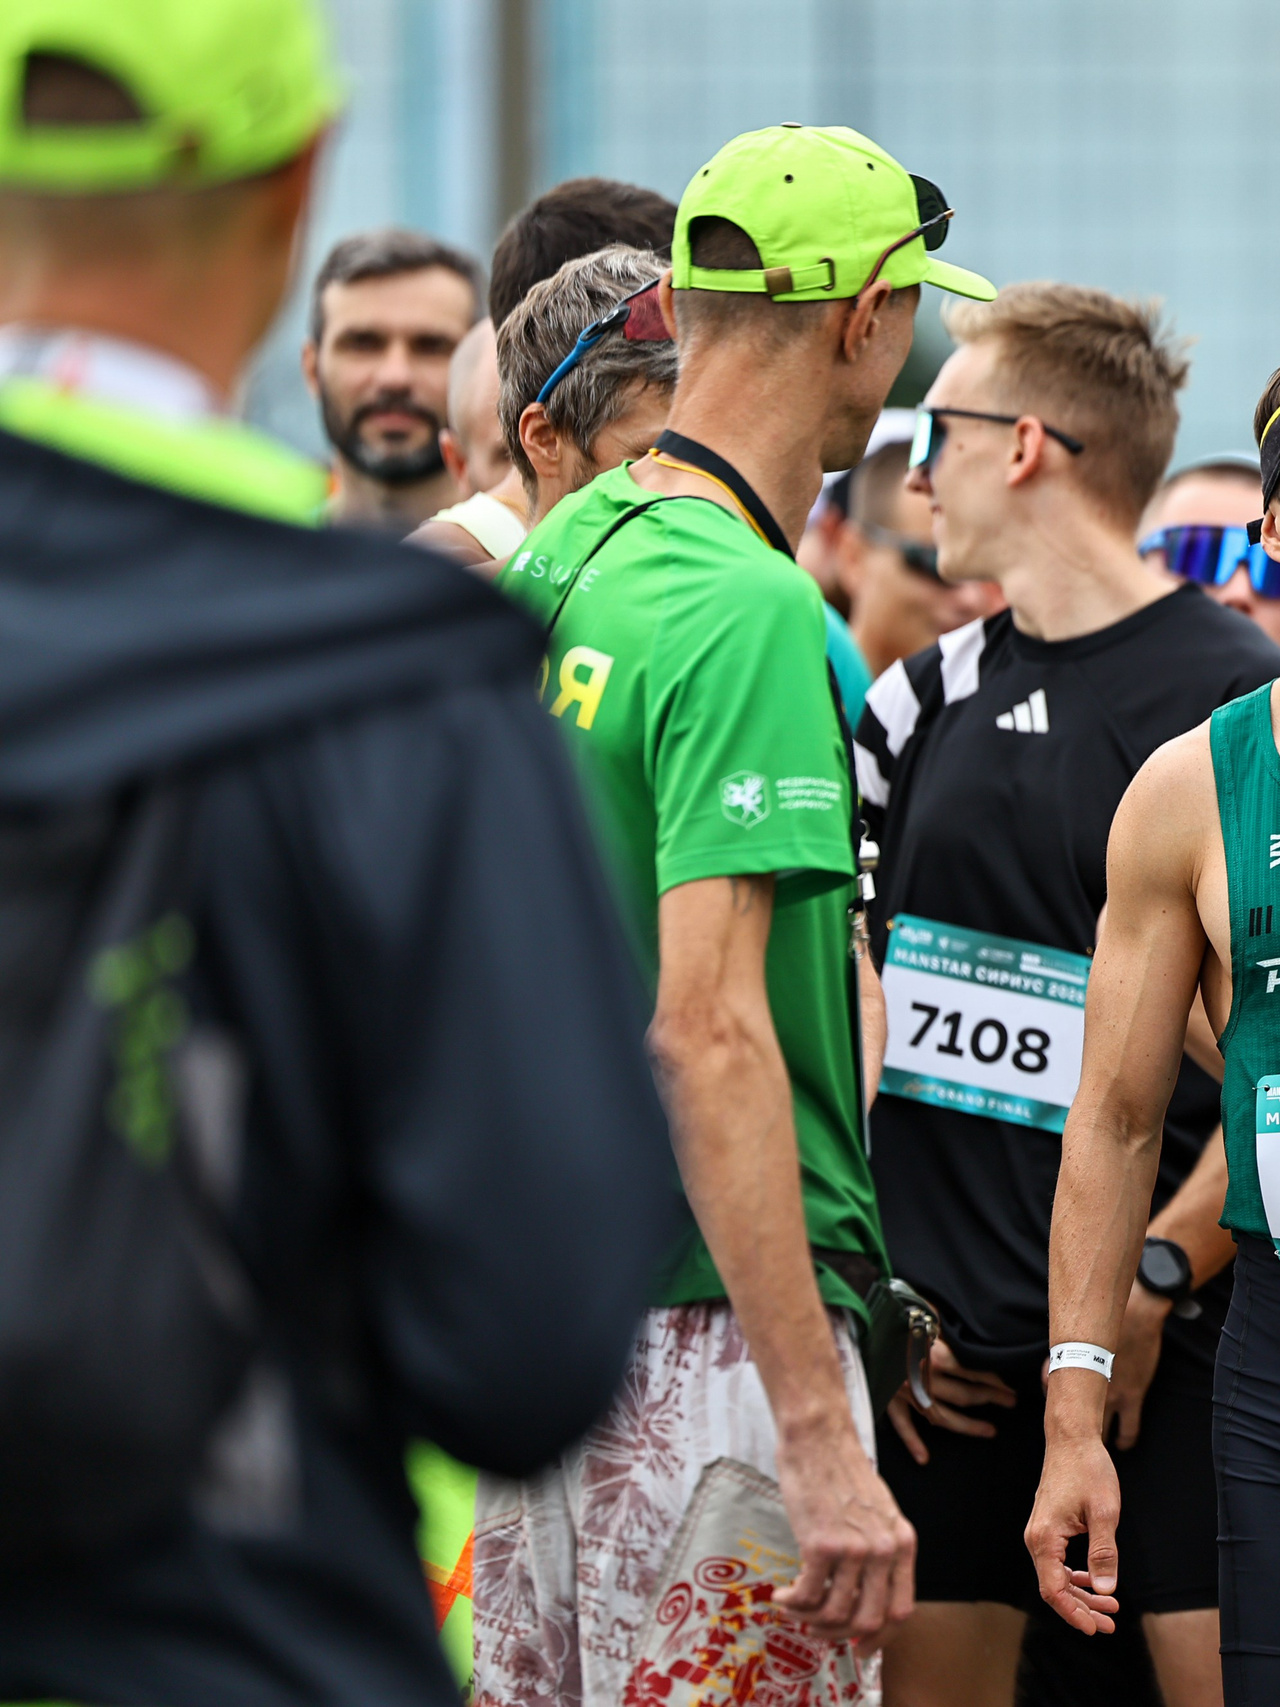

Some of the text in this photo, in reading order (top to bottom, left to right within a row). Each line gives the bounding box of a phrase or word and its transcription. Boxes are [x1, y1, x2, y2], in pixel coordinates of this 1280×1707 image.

[893, 948, 972, 979] MANSTAR
[975, 966, 1045, 994] СИРИУС
[909, 1002, 1050, 1074] 7108
